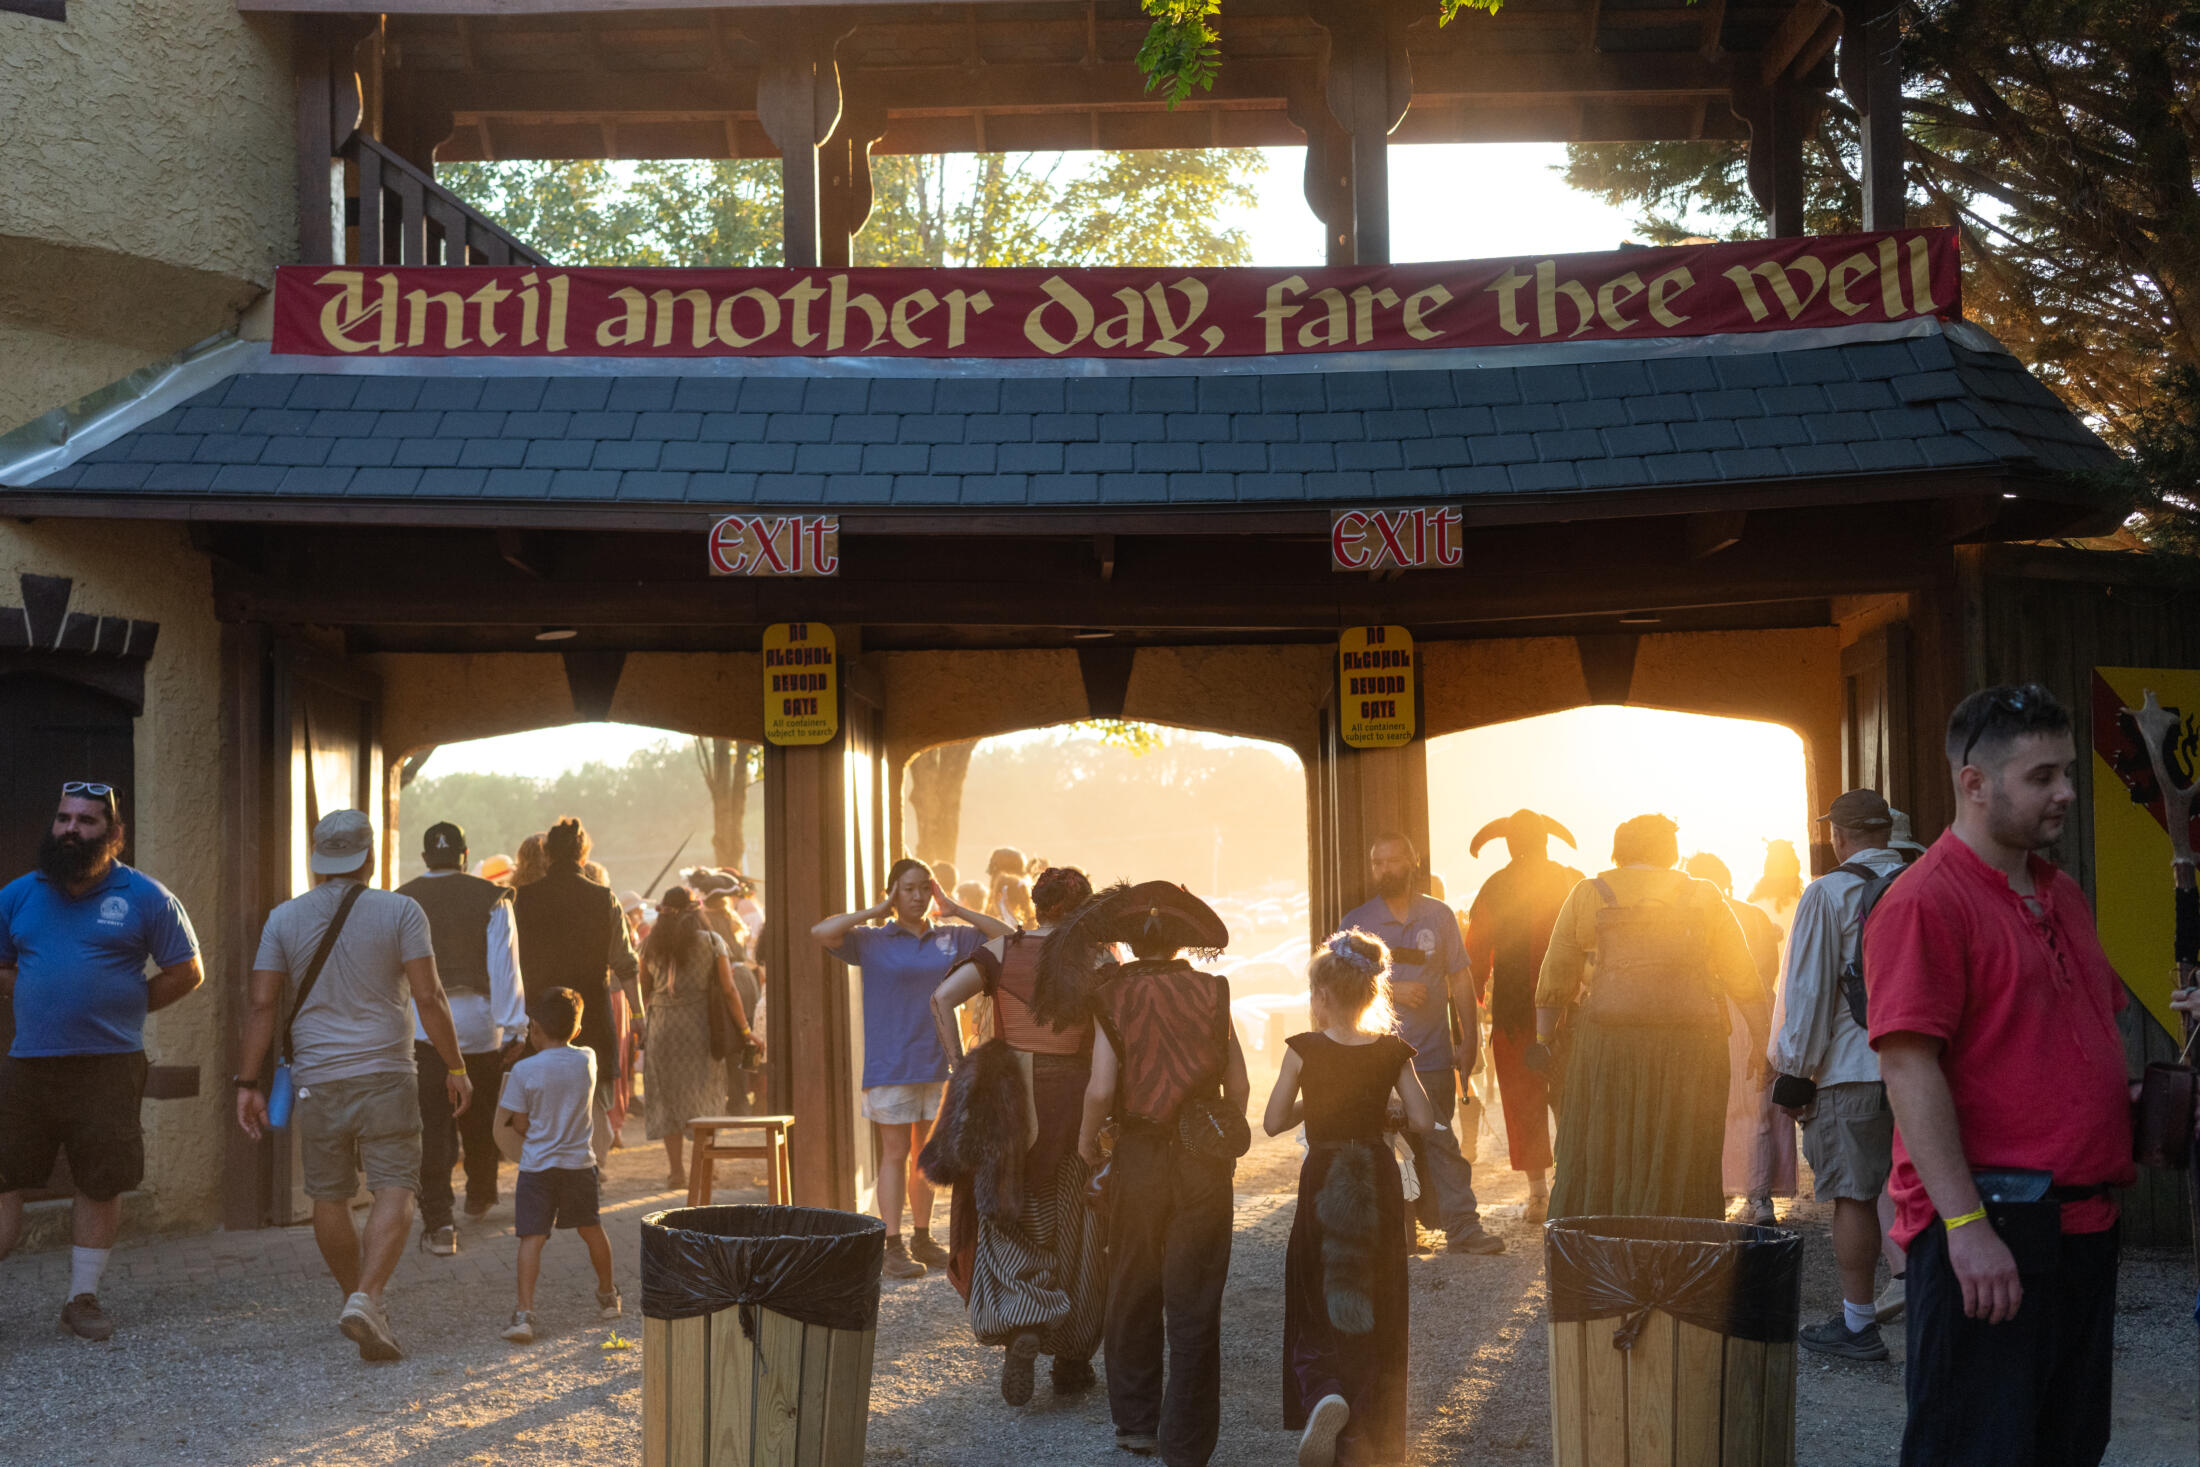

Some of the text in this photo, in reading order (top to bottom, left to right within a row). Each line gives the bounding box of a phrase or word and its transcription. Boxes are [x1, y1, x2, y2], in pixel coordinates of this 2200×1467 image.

[313, 234, 1939, 356] Until another day, fare thee well
[766, 647, 832, 668] ALCOHOL
[1343, 650, 1410, 671] ALCOHOL
[772, 673, 828, 692] BEYOND
[1350, 676, 1406, 695] BEYOND
[783, 698, 818, 716] GATE
[1361, 700, 1396, 719] GATE
[786, 718, 826, 728] containers
[1352, 722, 1406, 732] All containers
[767, 728, 833, 739] subject to search
[1346, 731, 1412, 742] subject to search
